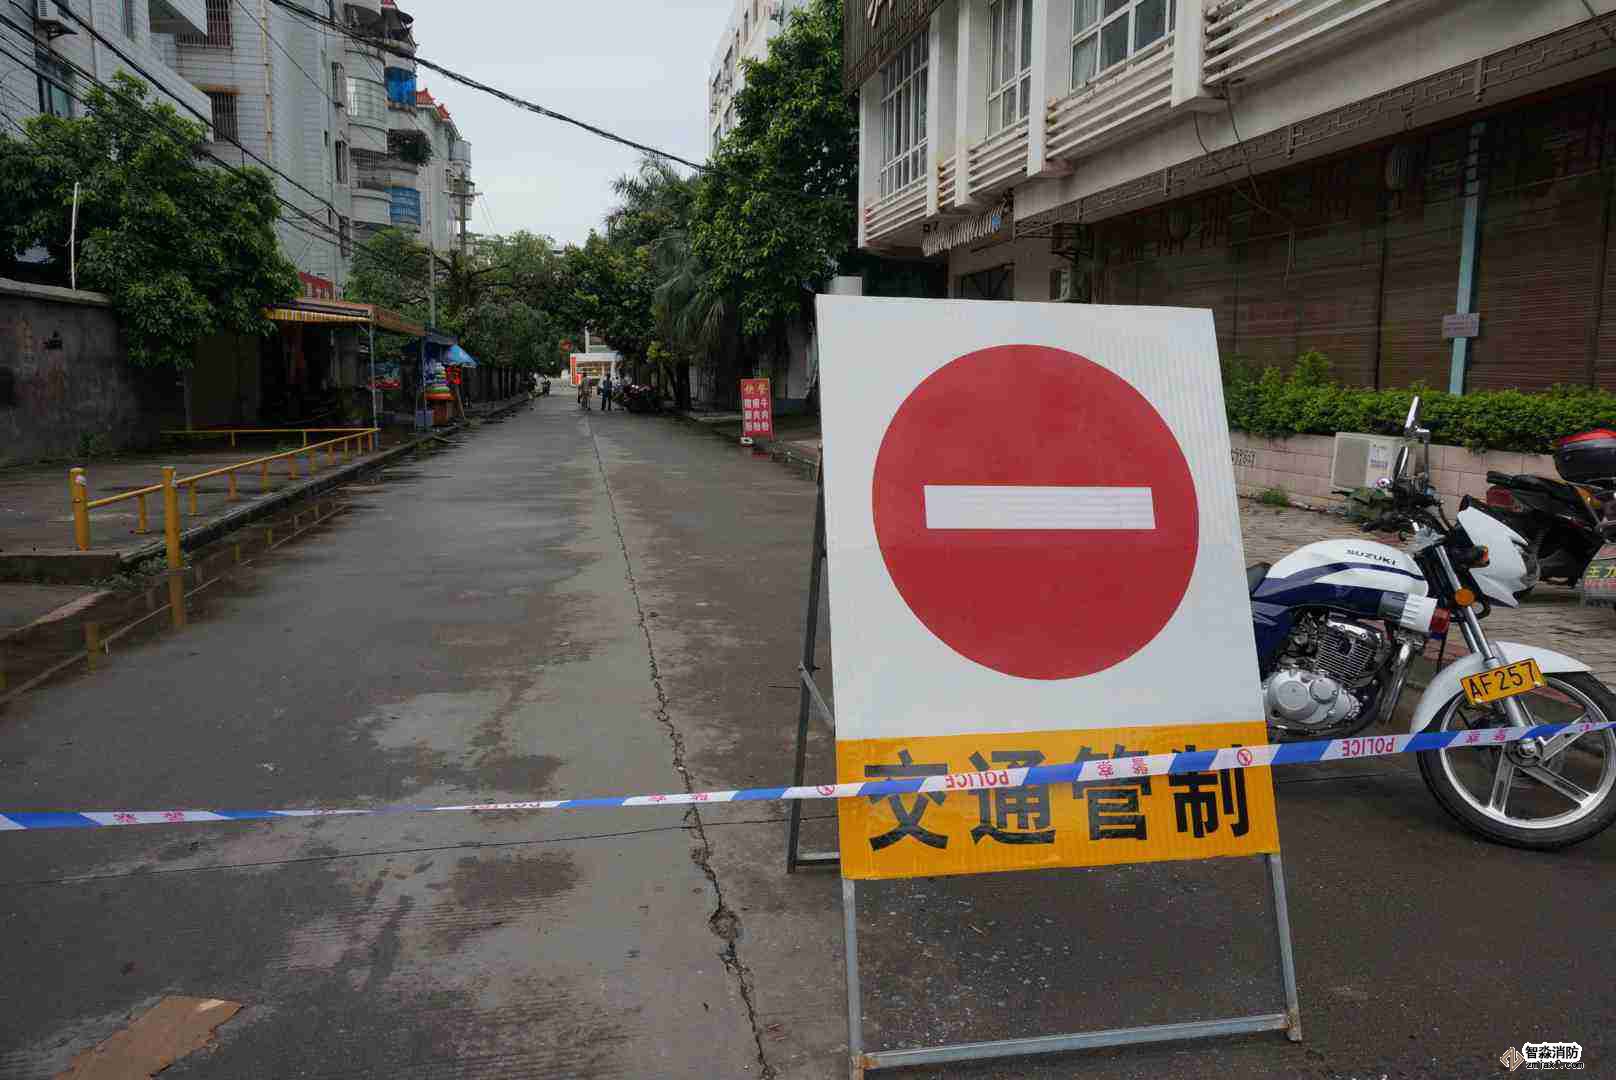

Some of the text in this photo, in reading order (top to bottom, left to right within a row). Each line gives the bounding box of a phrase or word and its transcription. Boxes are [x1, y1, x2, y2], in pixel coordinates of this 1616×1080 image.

[1346, 548, 1397, 566] SUZUKI
[1468, 661, 1535, 699] AF257
[1342, 736, 1398, 757] POLICE
[944, 770, 1009, 788] POLICE
[864, 743, 1250, 851] 交通管制
